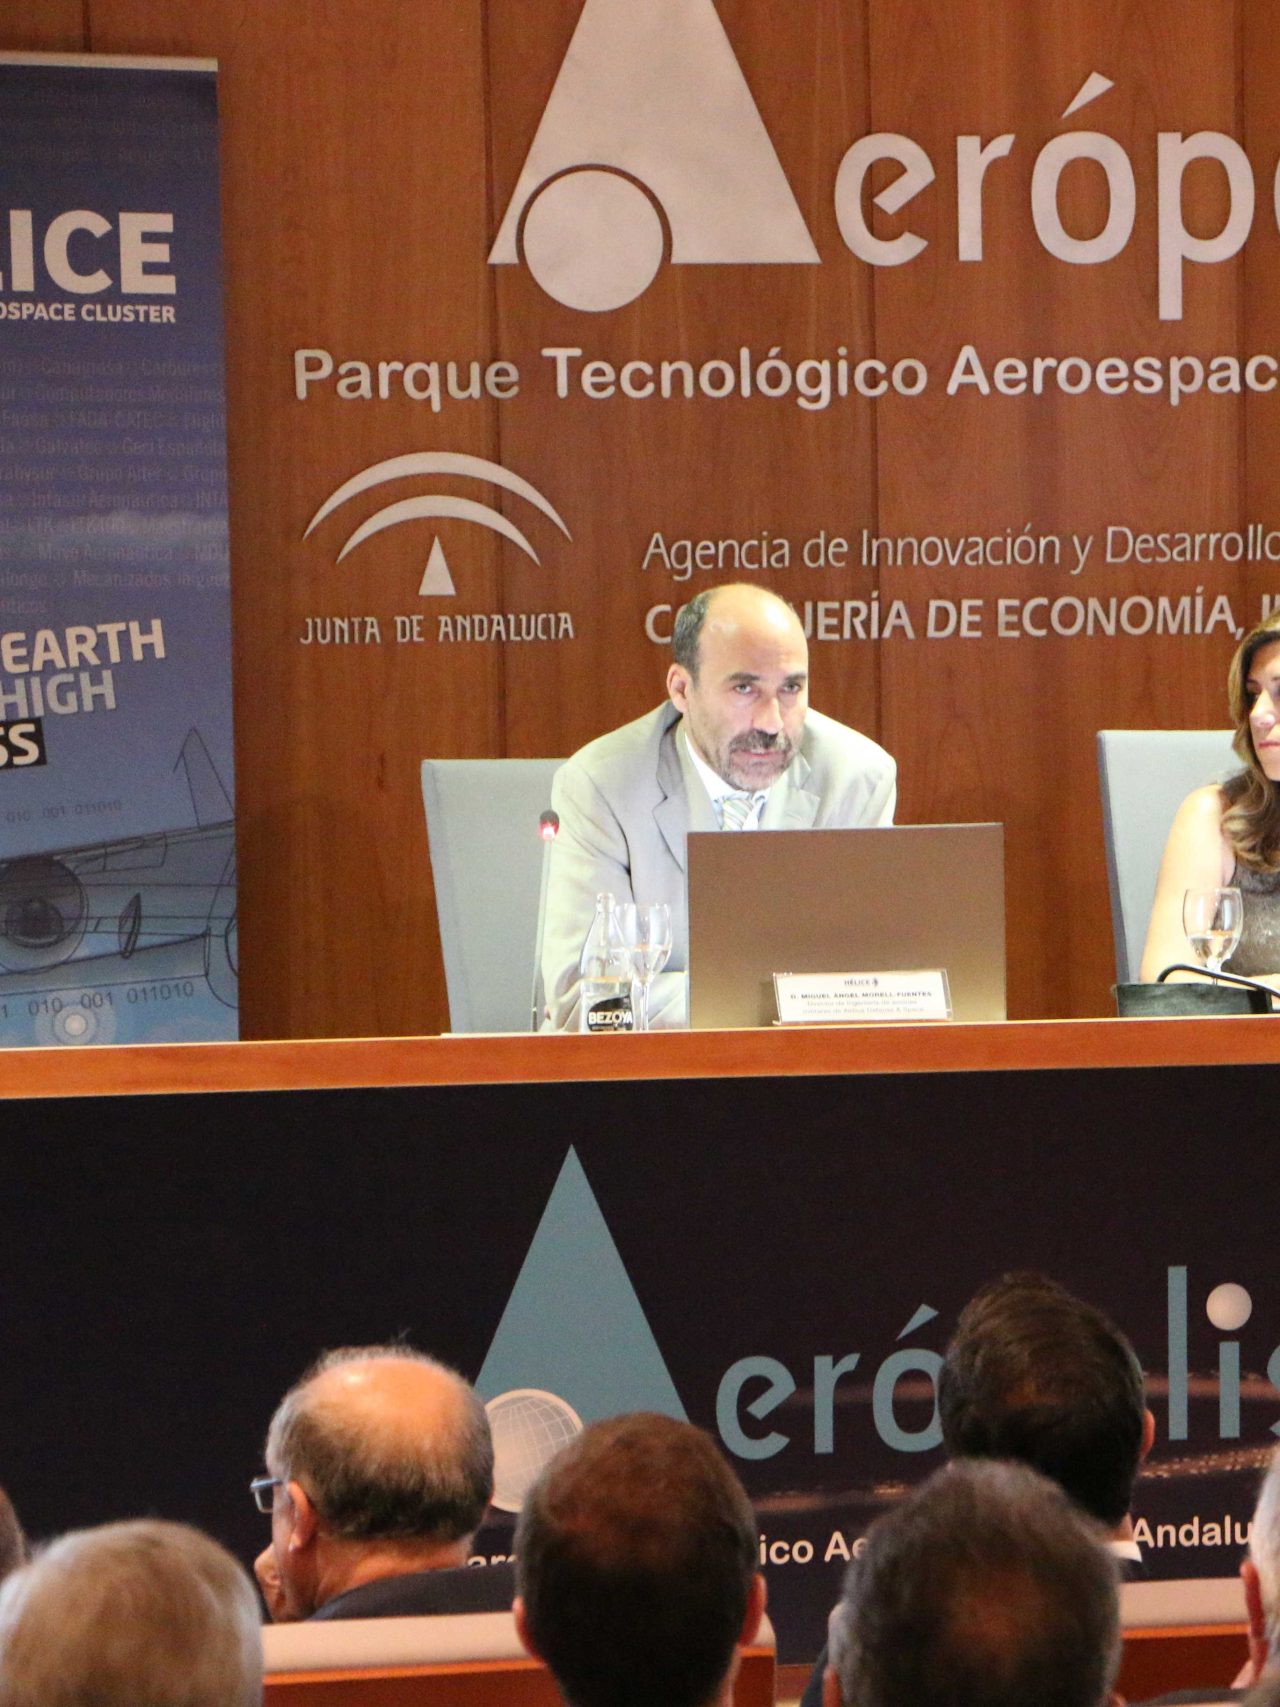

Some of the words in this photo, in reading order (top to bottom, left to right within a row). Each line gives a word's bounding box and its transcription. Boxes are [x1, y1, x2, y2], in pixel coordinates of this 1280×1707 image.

[0, 209, 176, 294] ICE
[81, 303, 176, 323] CLUSTER
[294, 348, 520, 413] Parque
[541, 345, 928, 412] Tecnológico
[642, 530, 790, 582] Agencia
[802, 530, 849, 569] de
[861, 522, 1060, 568] Innovación
[1070, 535, 1094, 576] y
[299, 616, 382, 645] JUNTA
[394, 615, 425, 644] DE
[438, 612, 575, 643] ANDALUCIA
[645, 590, 916, 644] CJERÍA
[926, 599, 984, 639] DE
[997, 585, 1244, 641] ECONOMÍA,
[1, 618, 166, 674] EARTH
[28, 997, 63, 1016] 010
[80, 992, 114, 1010] 001
[126, 982, 195, 1004] 011010
[588, 1008, 633, 1025] BEZOYA
